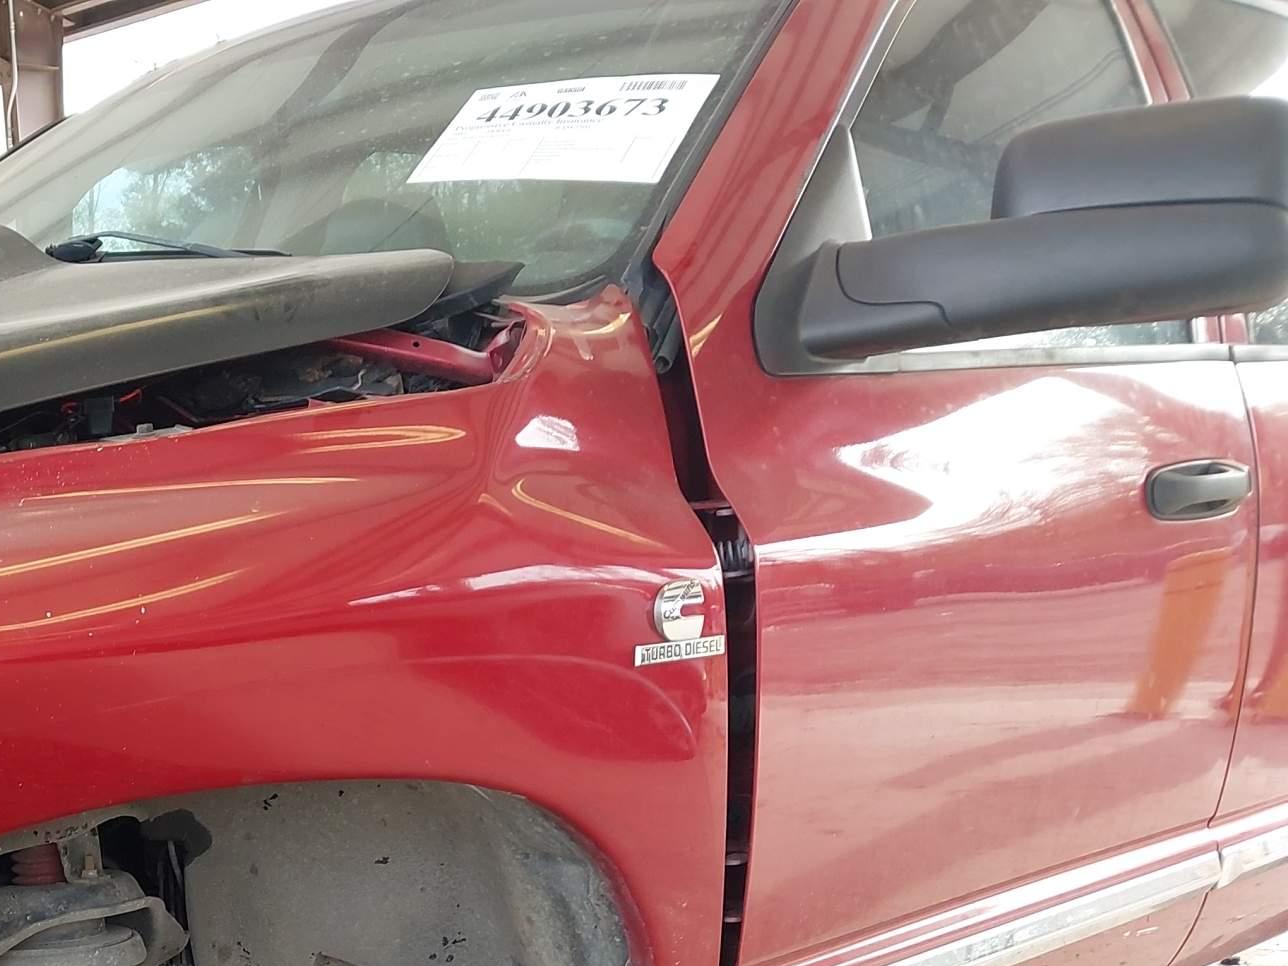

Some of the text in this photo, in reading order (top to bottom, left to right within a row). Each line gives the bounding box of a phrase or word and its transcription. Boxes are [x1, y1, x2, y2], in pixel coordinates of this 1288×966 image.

[476, 97, 669, 123] 44903673
[642, 639, 721, 663] TURBO DIESEL
